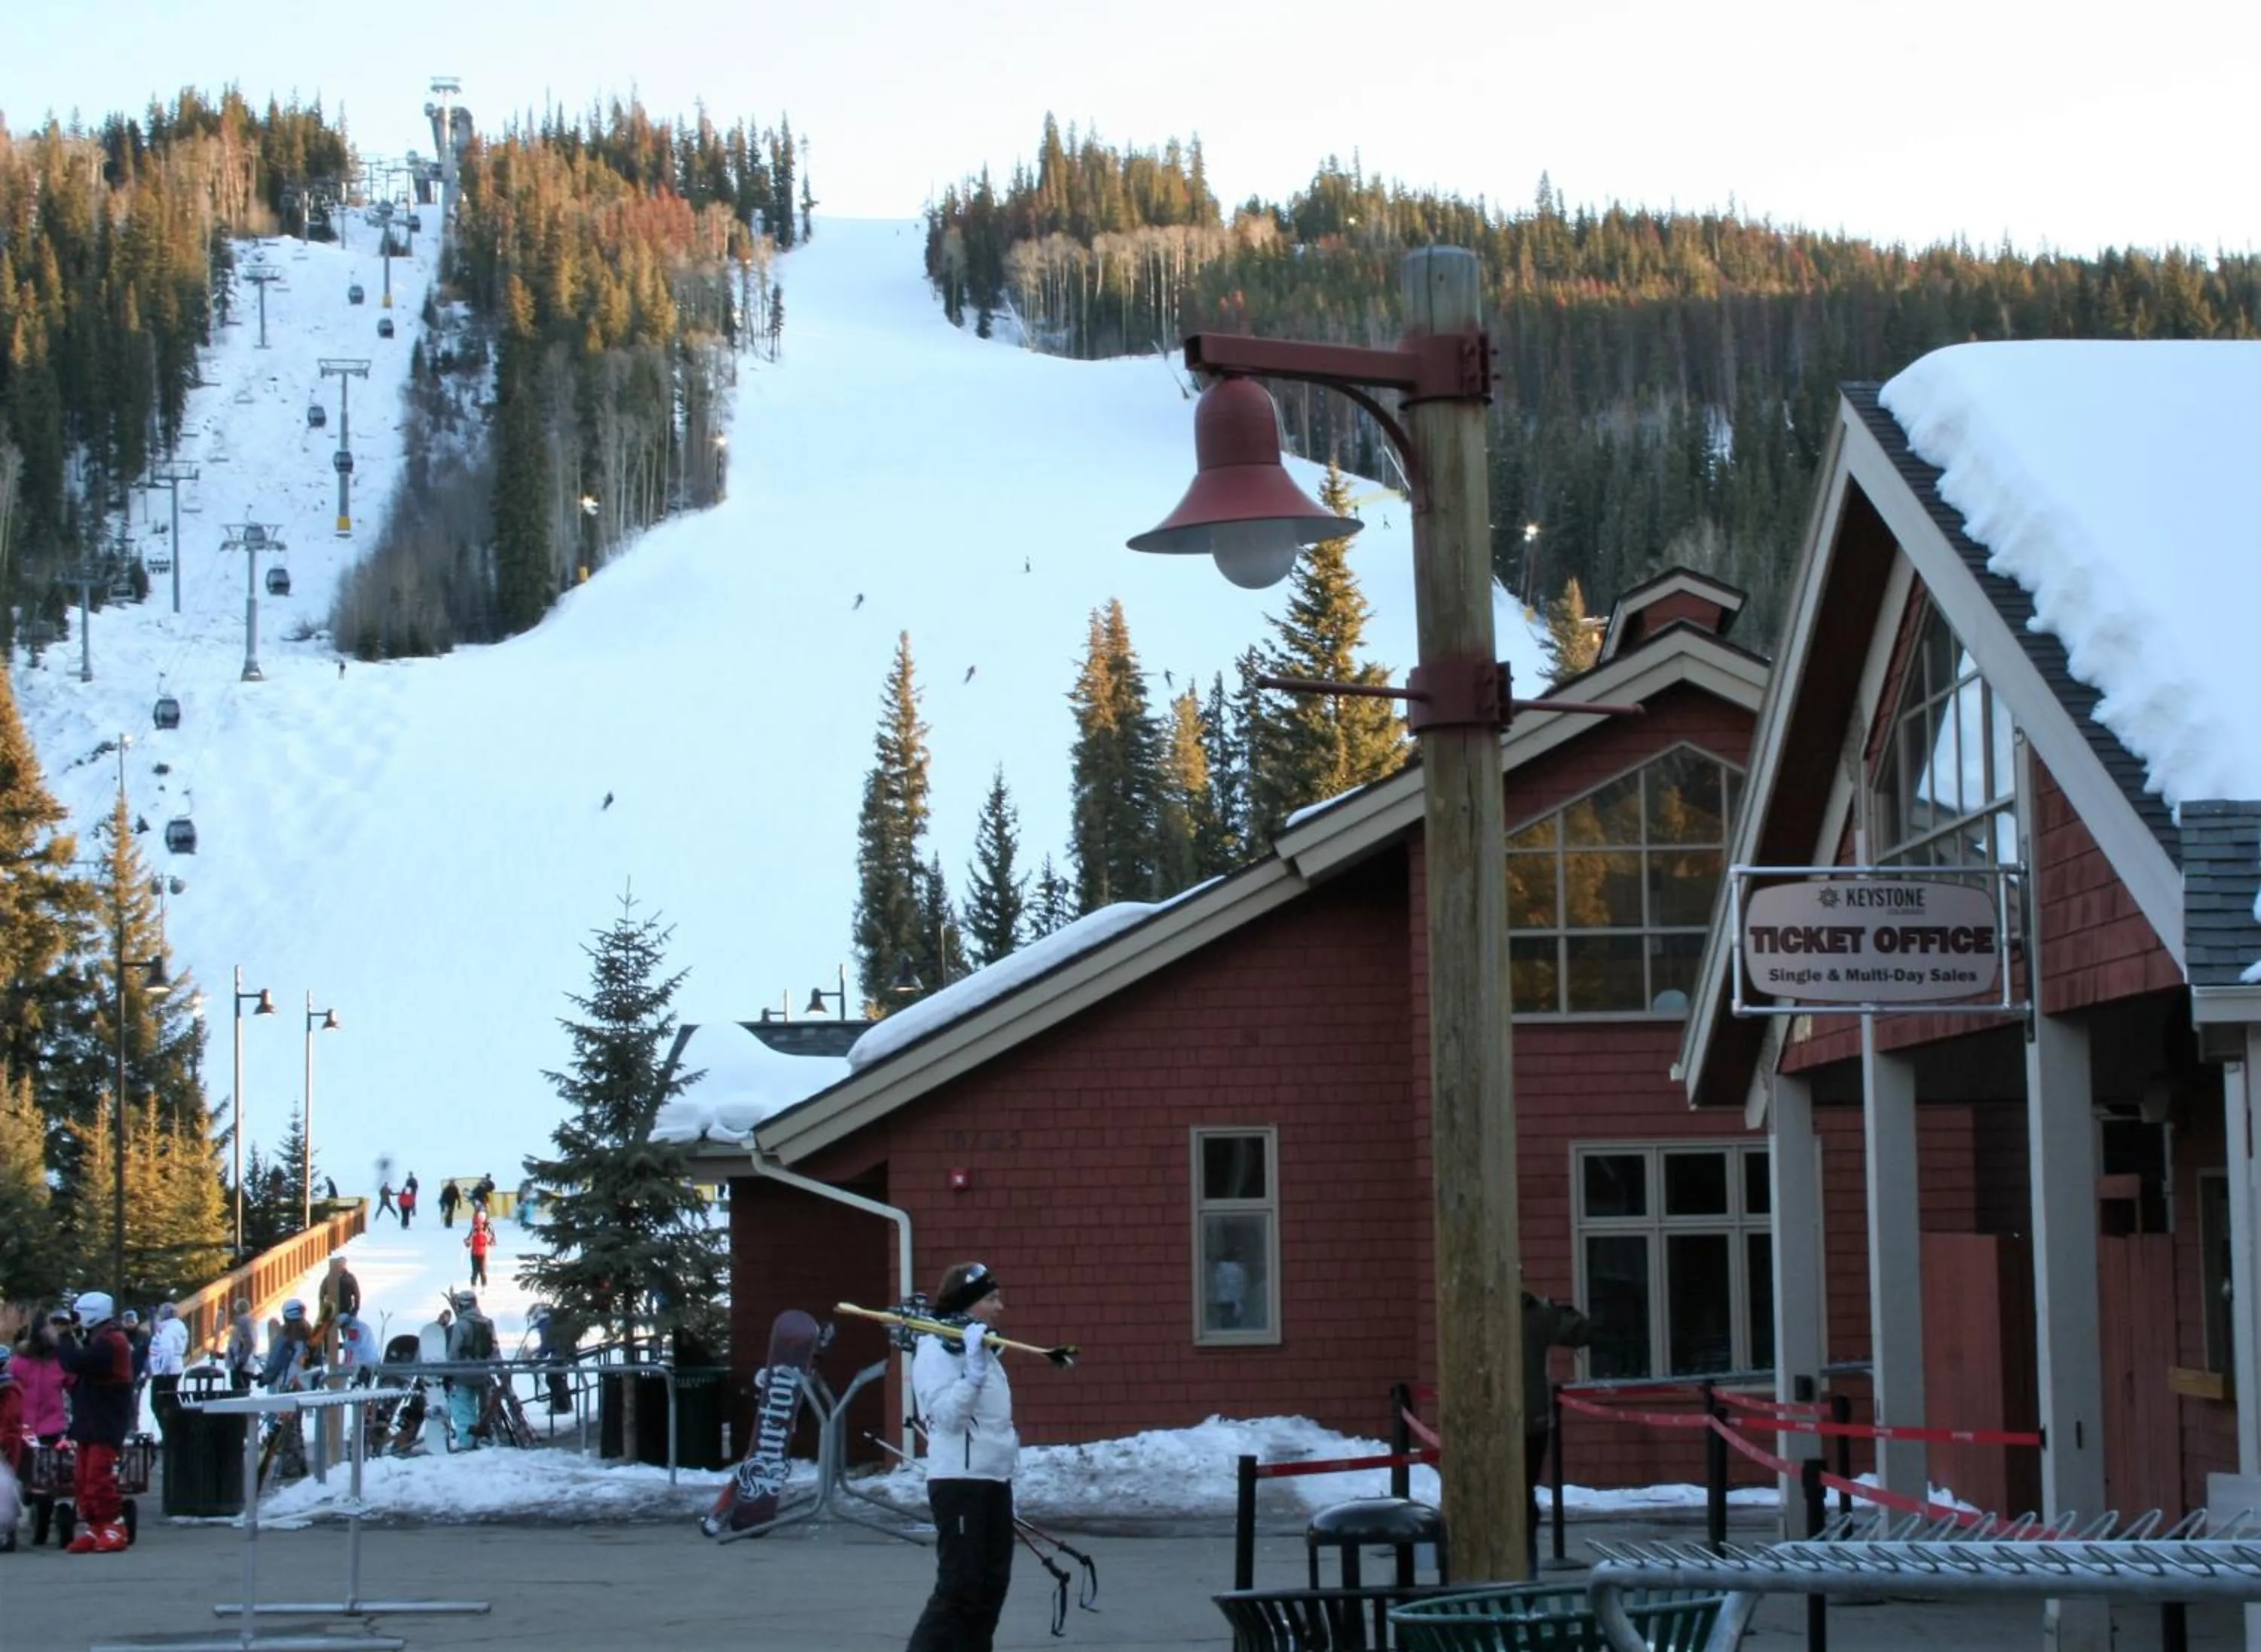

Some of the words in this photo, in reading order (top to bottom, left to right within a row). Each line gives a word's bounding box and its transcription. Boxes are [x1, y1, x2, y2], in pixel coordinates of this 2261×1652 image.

[1846, 887, 1926, 907] KEYSTONE
[1749, 925, 1865, 954] TICKET
[1873, 925, 1995, 954] OFFICE
[1768, 968, 1822, 984] Single
[1827, 968, 1840, 982] &
[1846, 968, 1925, 984] Multi-Day
[1930, 968, 1978, 983] Sales
[738, 1366, 800, 1501] Burton
